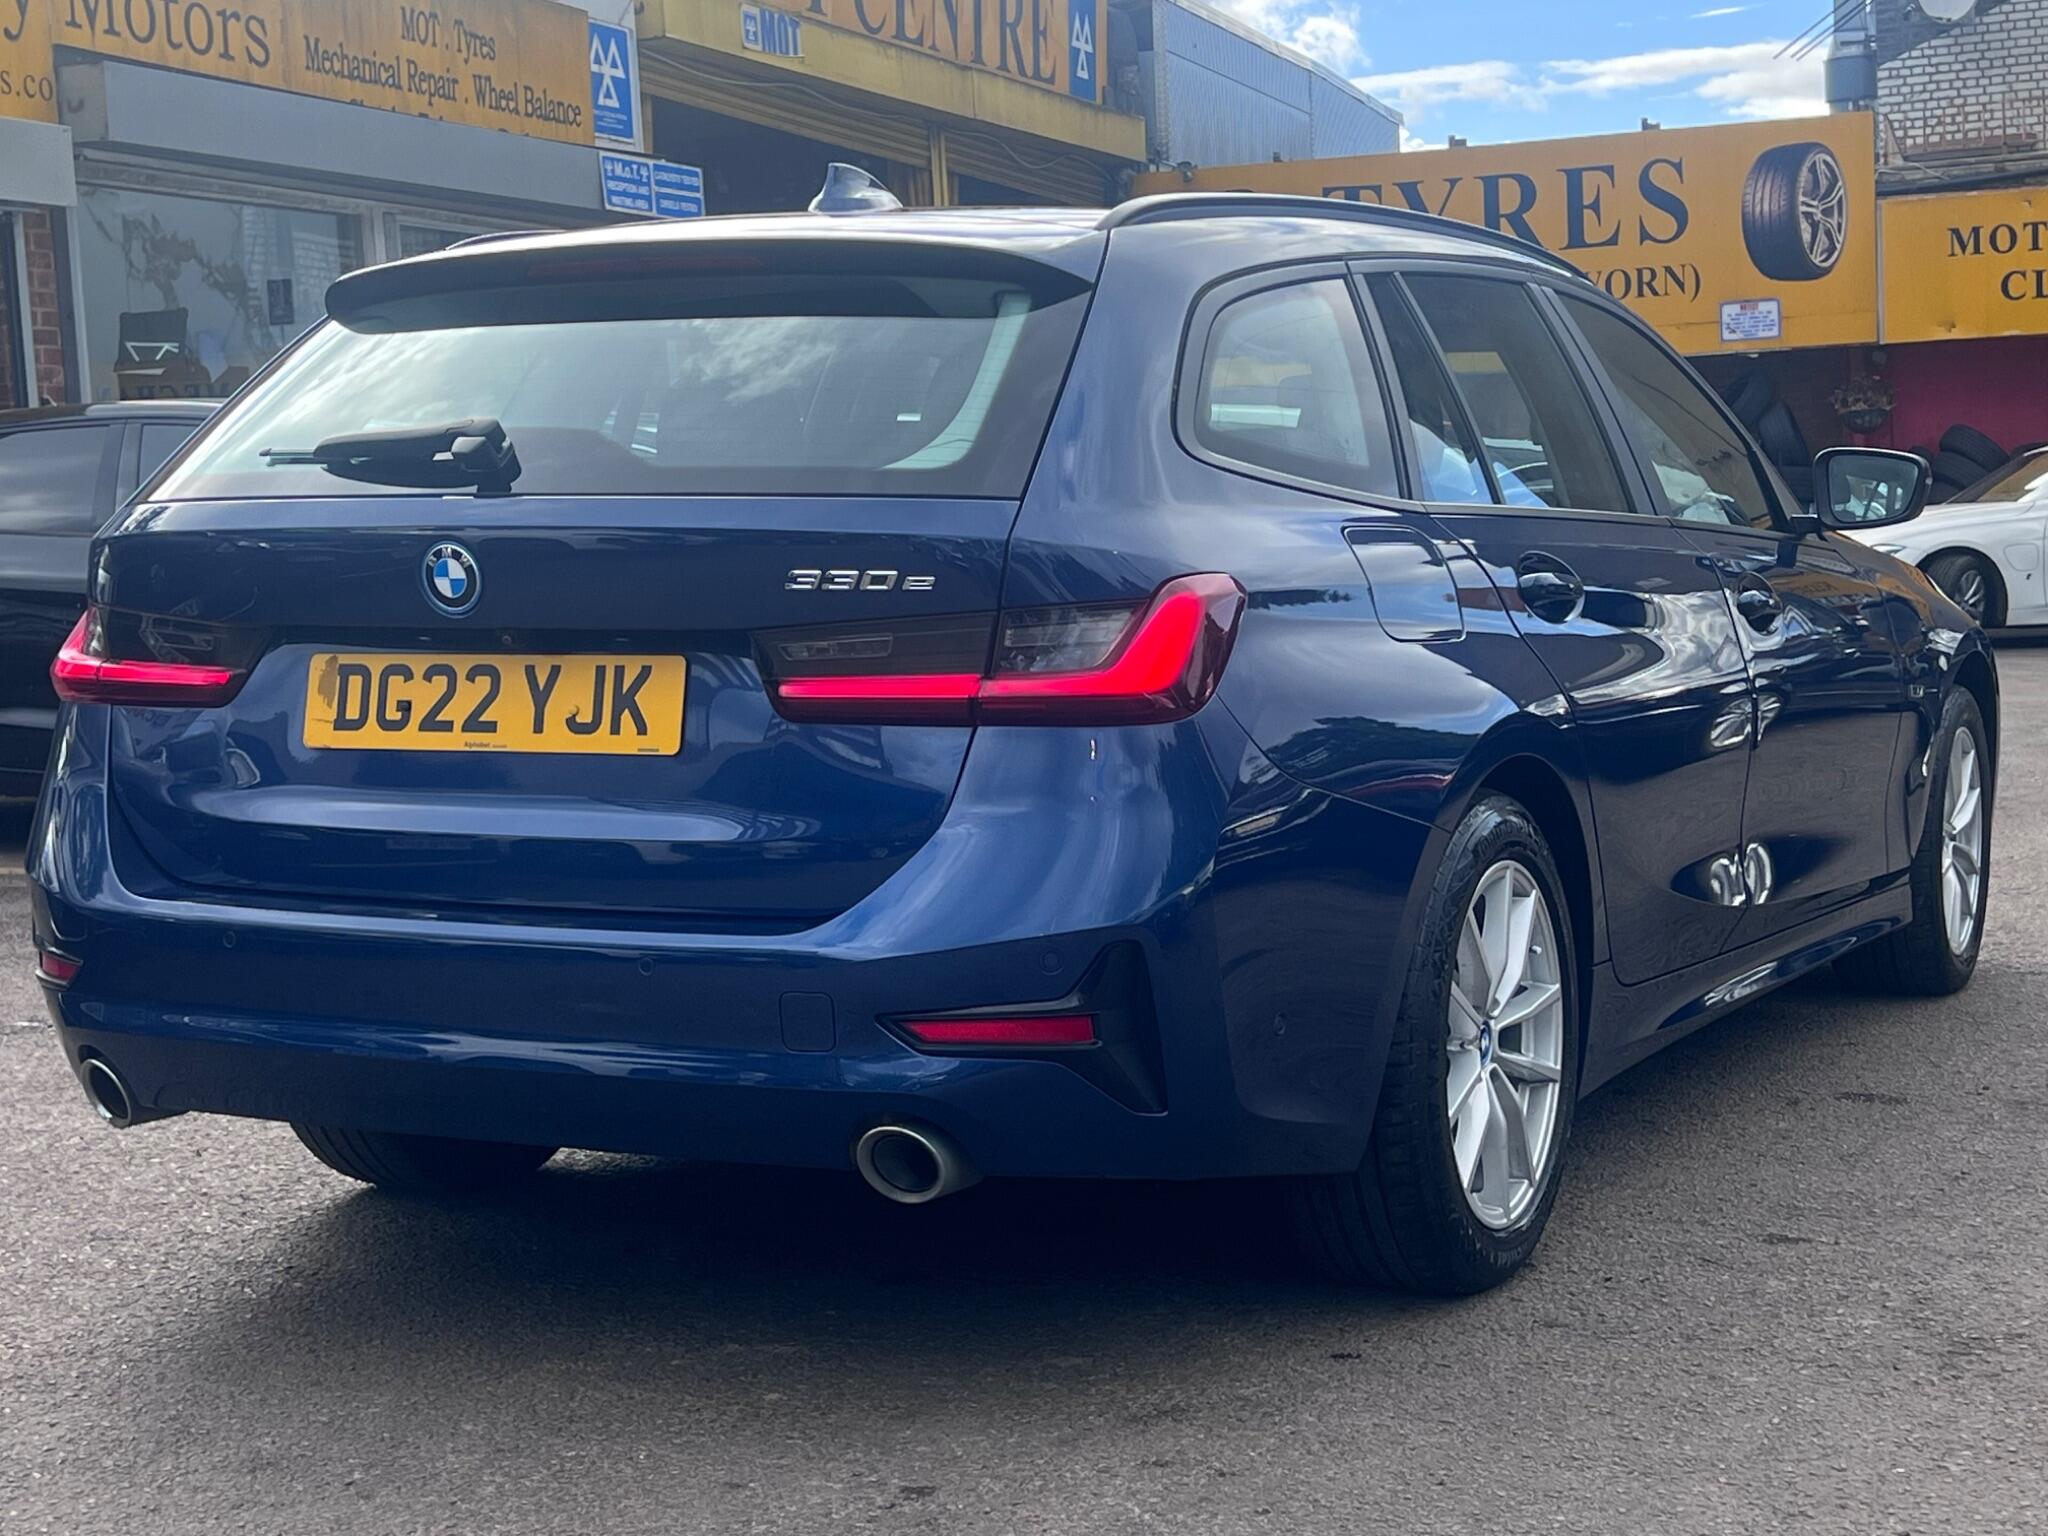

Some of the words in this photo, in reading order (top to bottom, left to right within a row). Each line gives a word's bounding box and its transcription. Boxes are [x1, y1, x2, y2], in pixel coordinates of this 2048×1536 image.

[401, 6, 441, 47] MOT
[453, 19, 497, 64] Tyres
[760, 8, 801, 56] MOT
[303, 34, 402, 91] Mechanical
[406, 58, 459, 107] Repair
[472, 73, 521, 116] Wheel
[523, 85, 583, 128] Balance
[1322, 157, 1689, 252] RES
[1947, 220, 2048, 257] MOT
[427, 546, 473, 569] BMW
[785, 569, 936, 590] 330e
[333, 663, 501, 734] DG22
[524, 664, 653, 737] YJK
